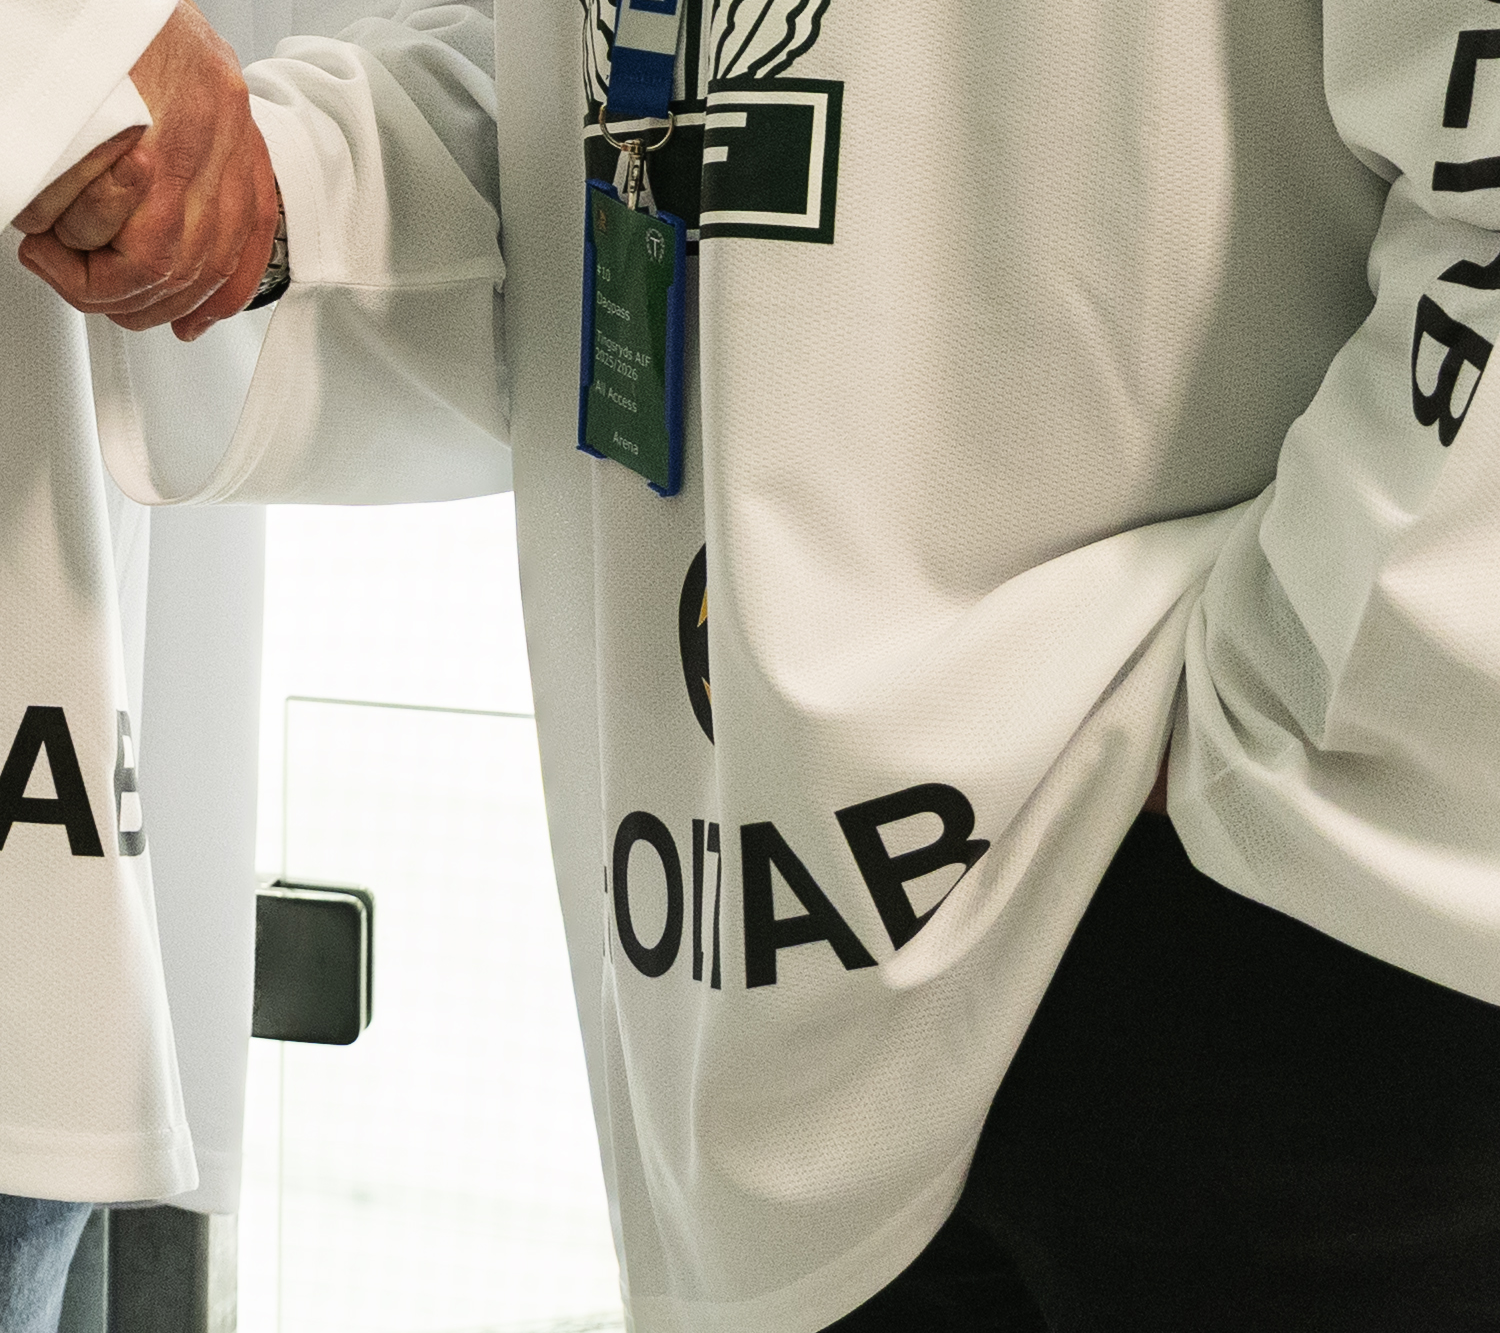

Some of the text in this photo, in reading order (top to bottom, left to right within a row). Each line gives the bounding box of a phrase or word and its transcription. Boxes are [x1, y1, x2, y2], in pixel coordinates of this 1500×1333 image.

[597, 290, 631, 322] Dagpass
[595, 346, 639, 381] 2025/2026
[634, 352, 652, 367] AIF
[607, 387, 638, 413] Access
[612, 431, 639, 456] Arena
